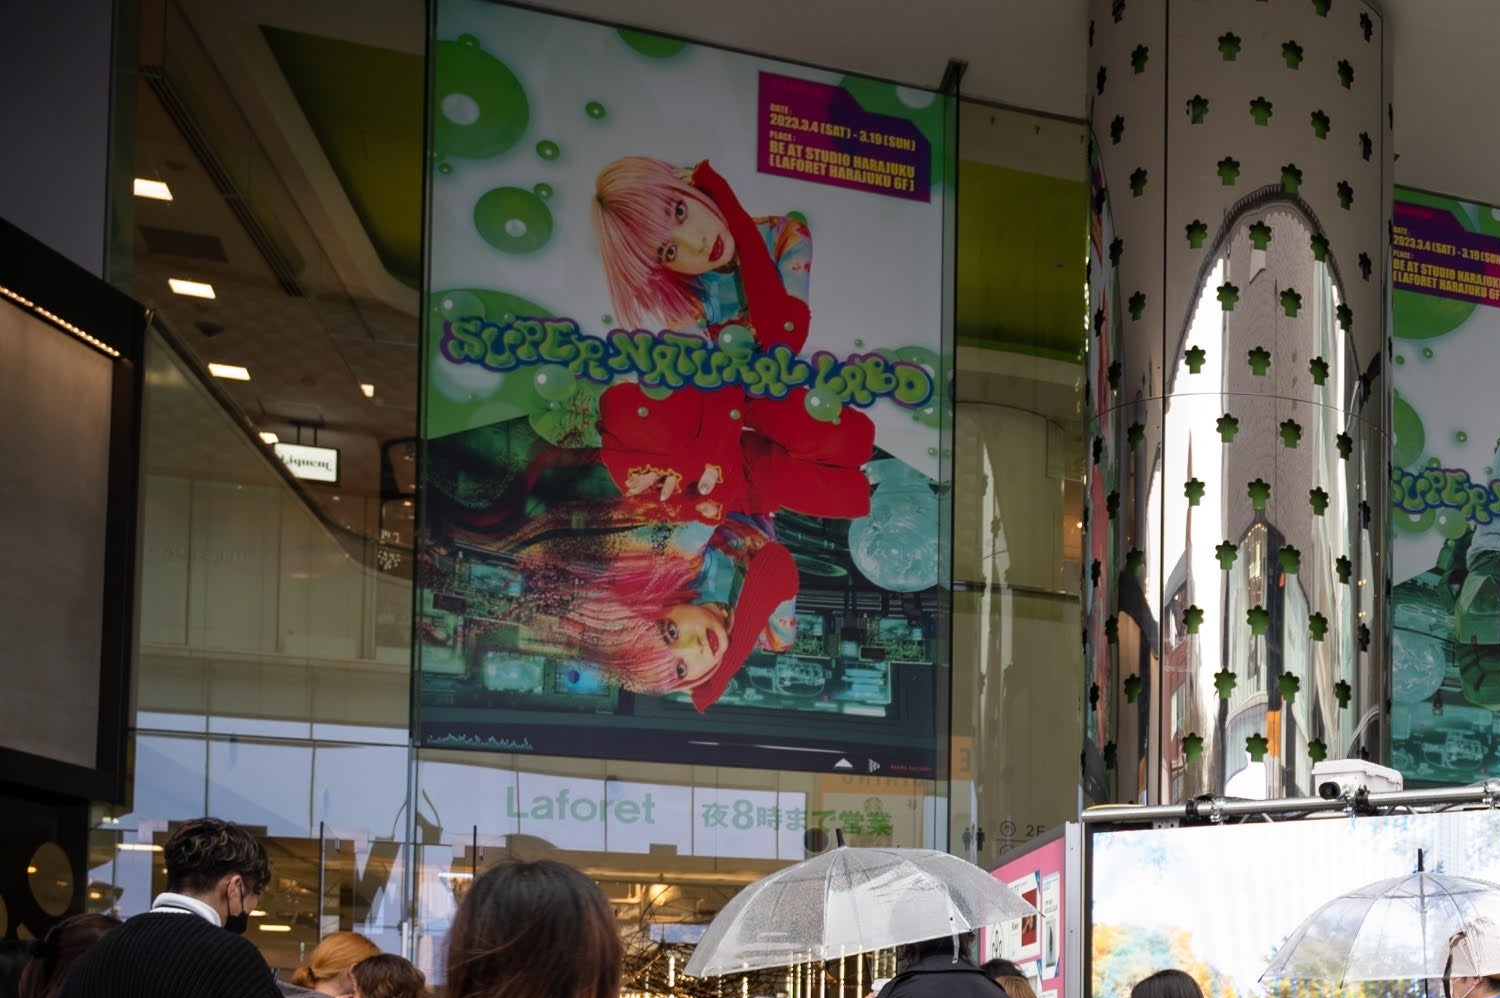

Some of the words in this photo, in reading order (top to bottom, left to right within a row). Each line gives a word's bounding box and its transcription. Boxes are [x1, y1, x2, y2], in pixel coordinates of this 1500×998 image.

[769, 141, 786, 155] BE
[787, 144, 803, 157] AT
[805, 147, 850, 166] STUDIO
[853, 155, 915, 178] HARAJUKU
[829, 164, 891, 189] HARAJUKU
[1407, 262, 1419, 273] AT
[1421, 263, 1455, 280] STUDIO
[1439, 279, 1487, 298] HARAJUKU
[442, 317, 607, 382] SUPER
[608, 330, 808, 399] NATURAL
[1393, 467, 1492, 525] UPER
[506, 786, 655, 825] Laforet
[701, 799, 893, 836] 夜8時まで営業
